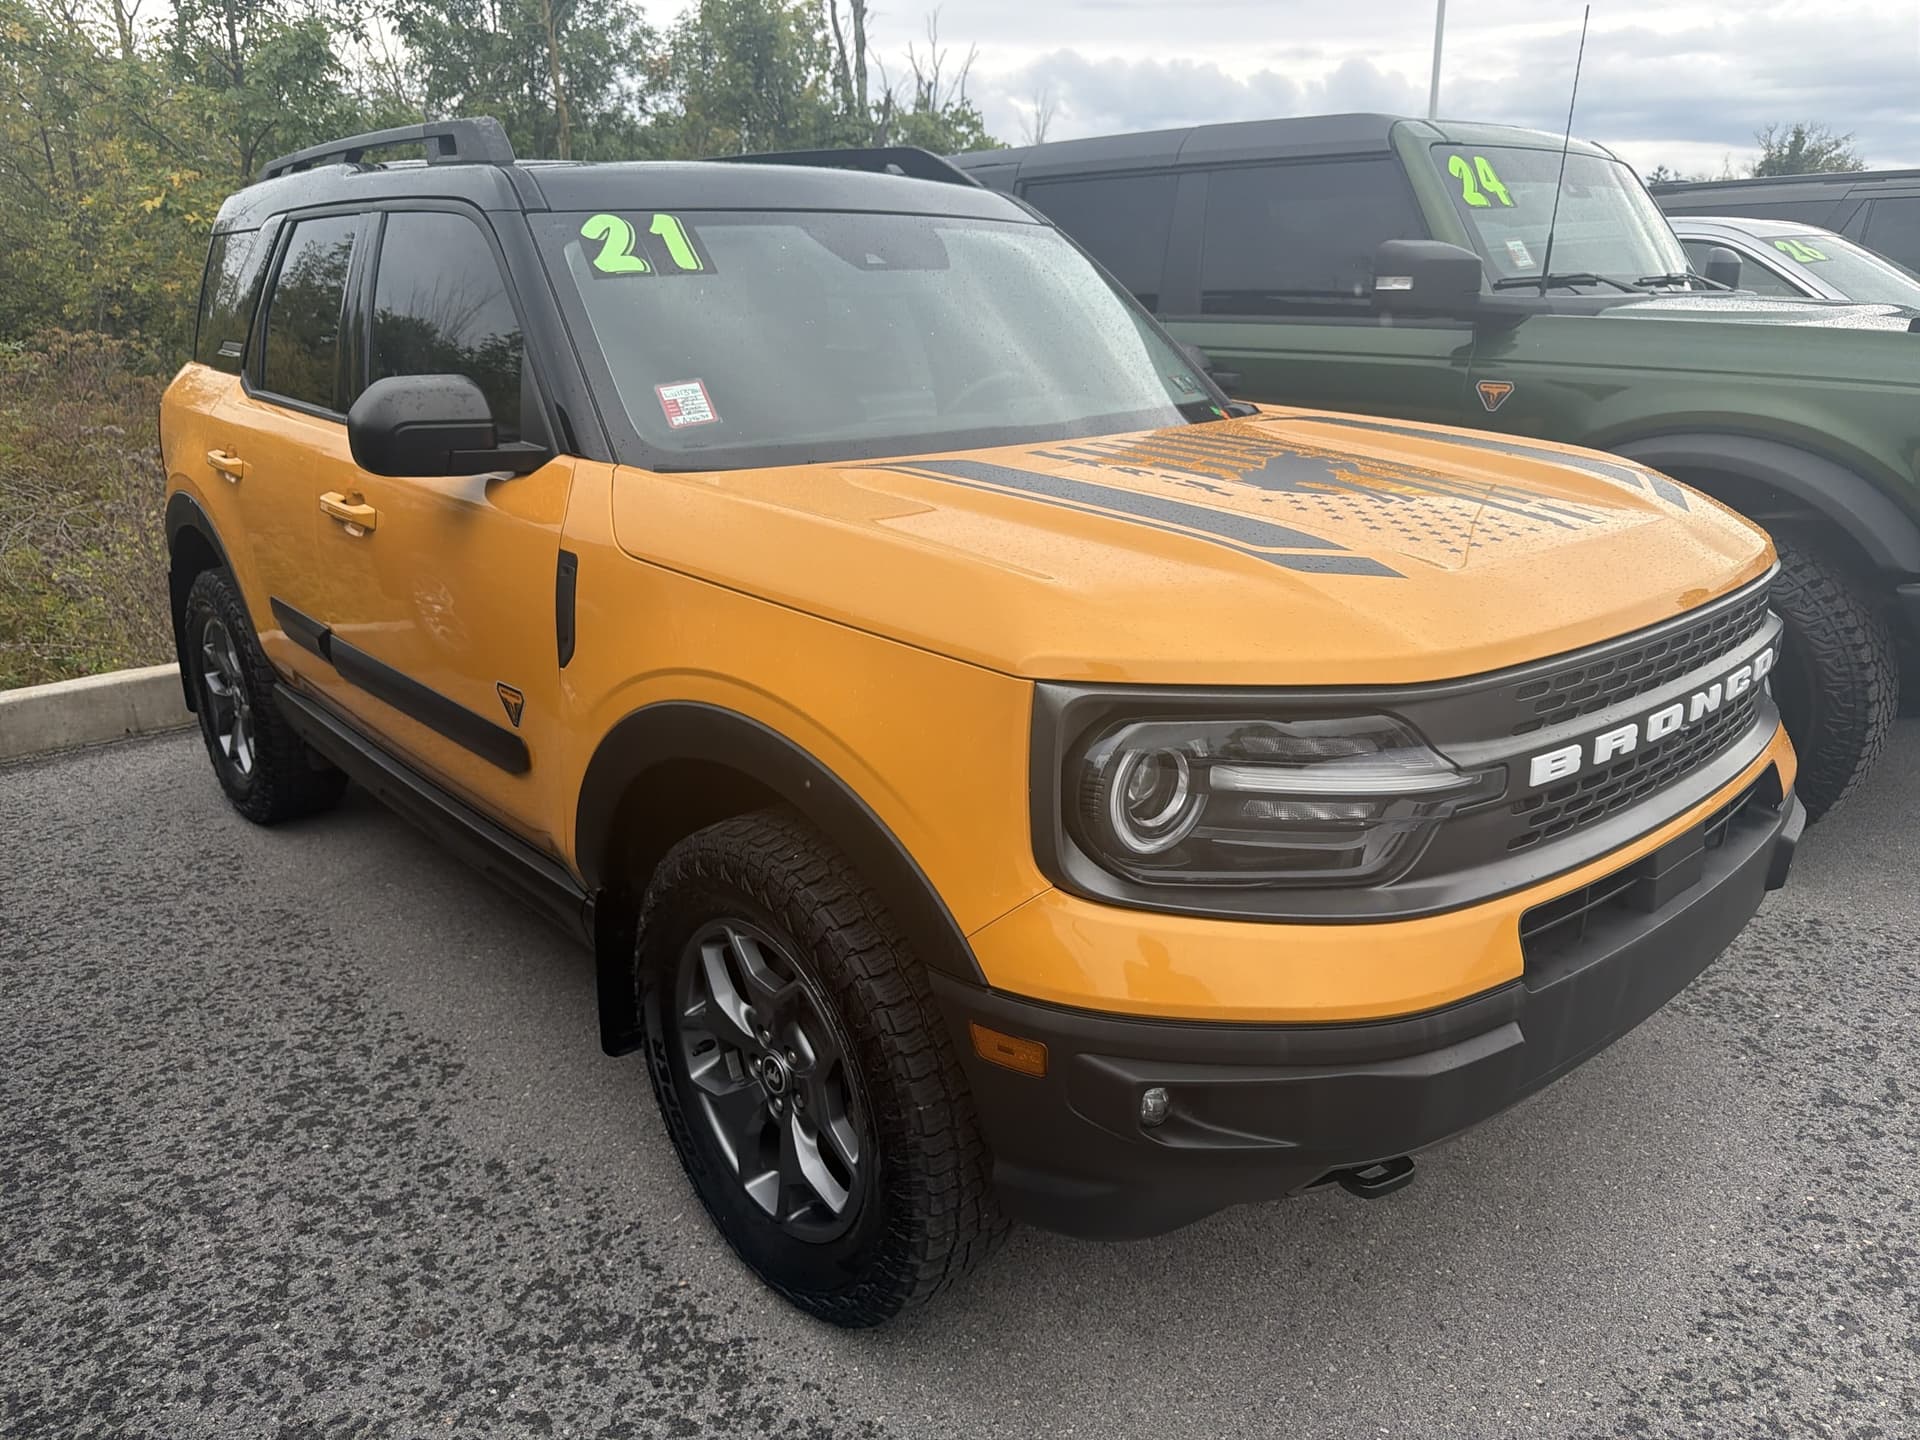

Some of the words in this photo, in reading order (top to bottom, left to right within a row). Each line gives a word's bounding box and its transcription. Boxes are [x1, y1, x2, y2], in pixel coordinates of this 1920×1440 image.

[1448, 155, 1514, 207] 24
[580, 213, 704, 273] 21
[1774, 239, 1828, 262] 26
[1529, 648, 1773, 787] BRONCO
